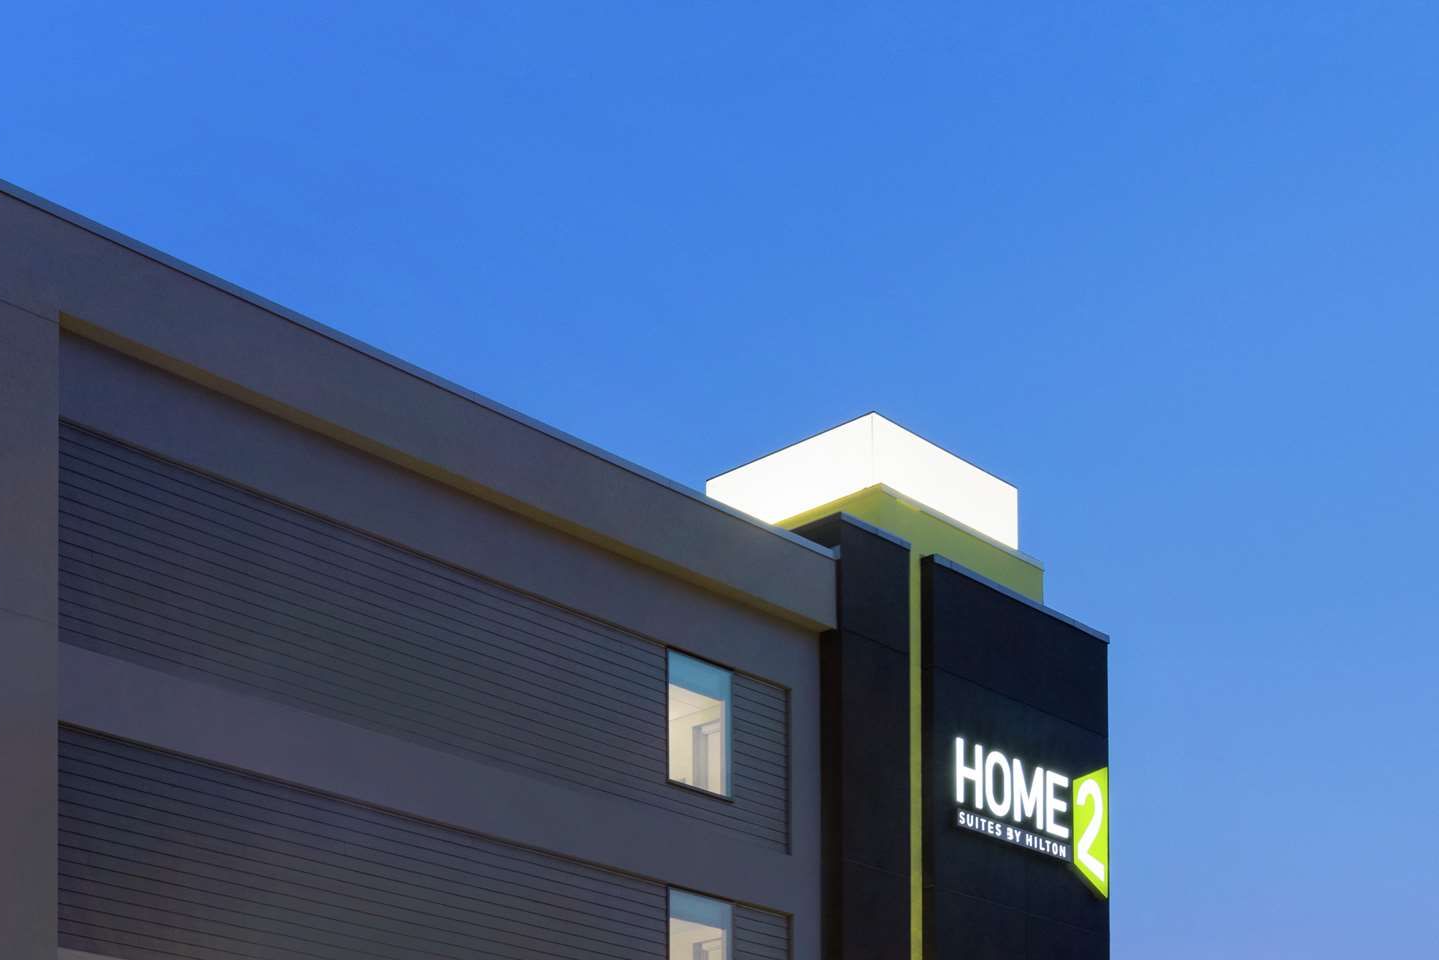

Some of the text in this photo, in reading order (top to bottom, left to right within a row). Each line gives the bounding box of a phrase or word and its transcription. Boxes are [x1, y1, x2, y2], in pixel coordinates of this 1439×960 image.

[955, 736, 1105, 882] HOME 2
[959, 811, 1067, 858] SUITES BY HILTON
